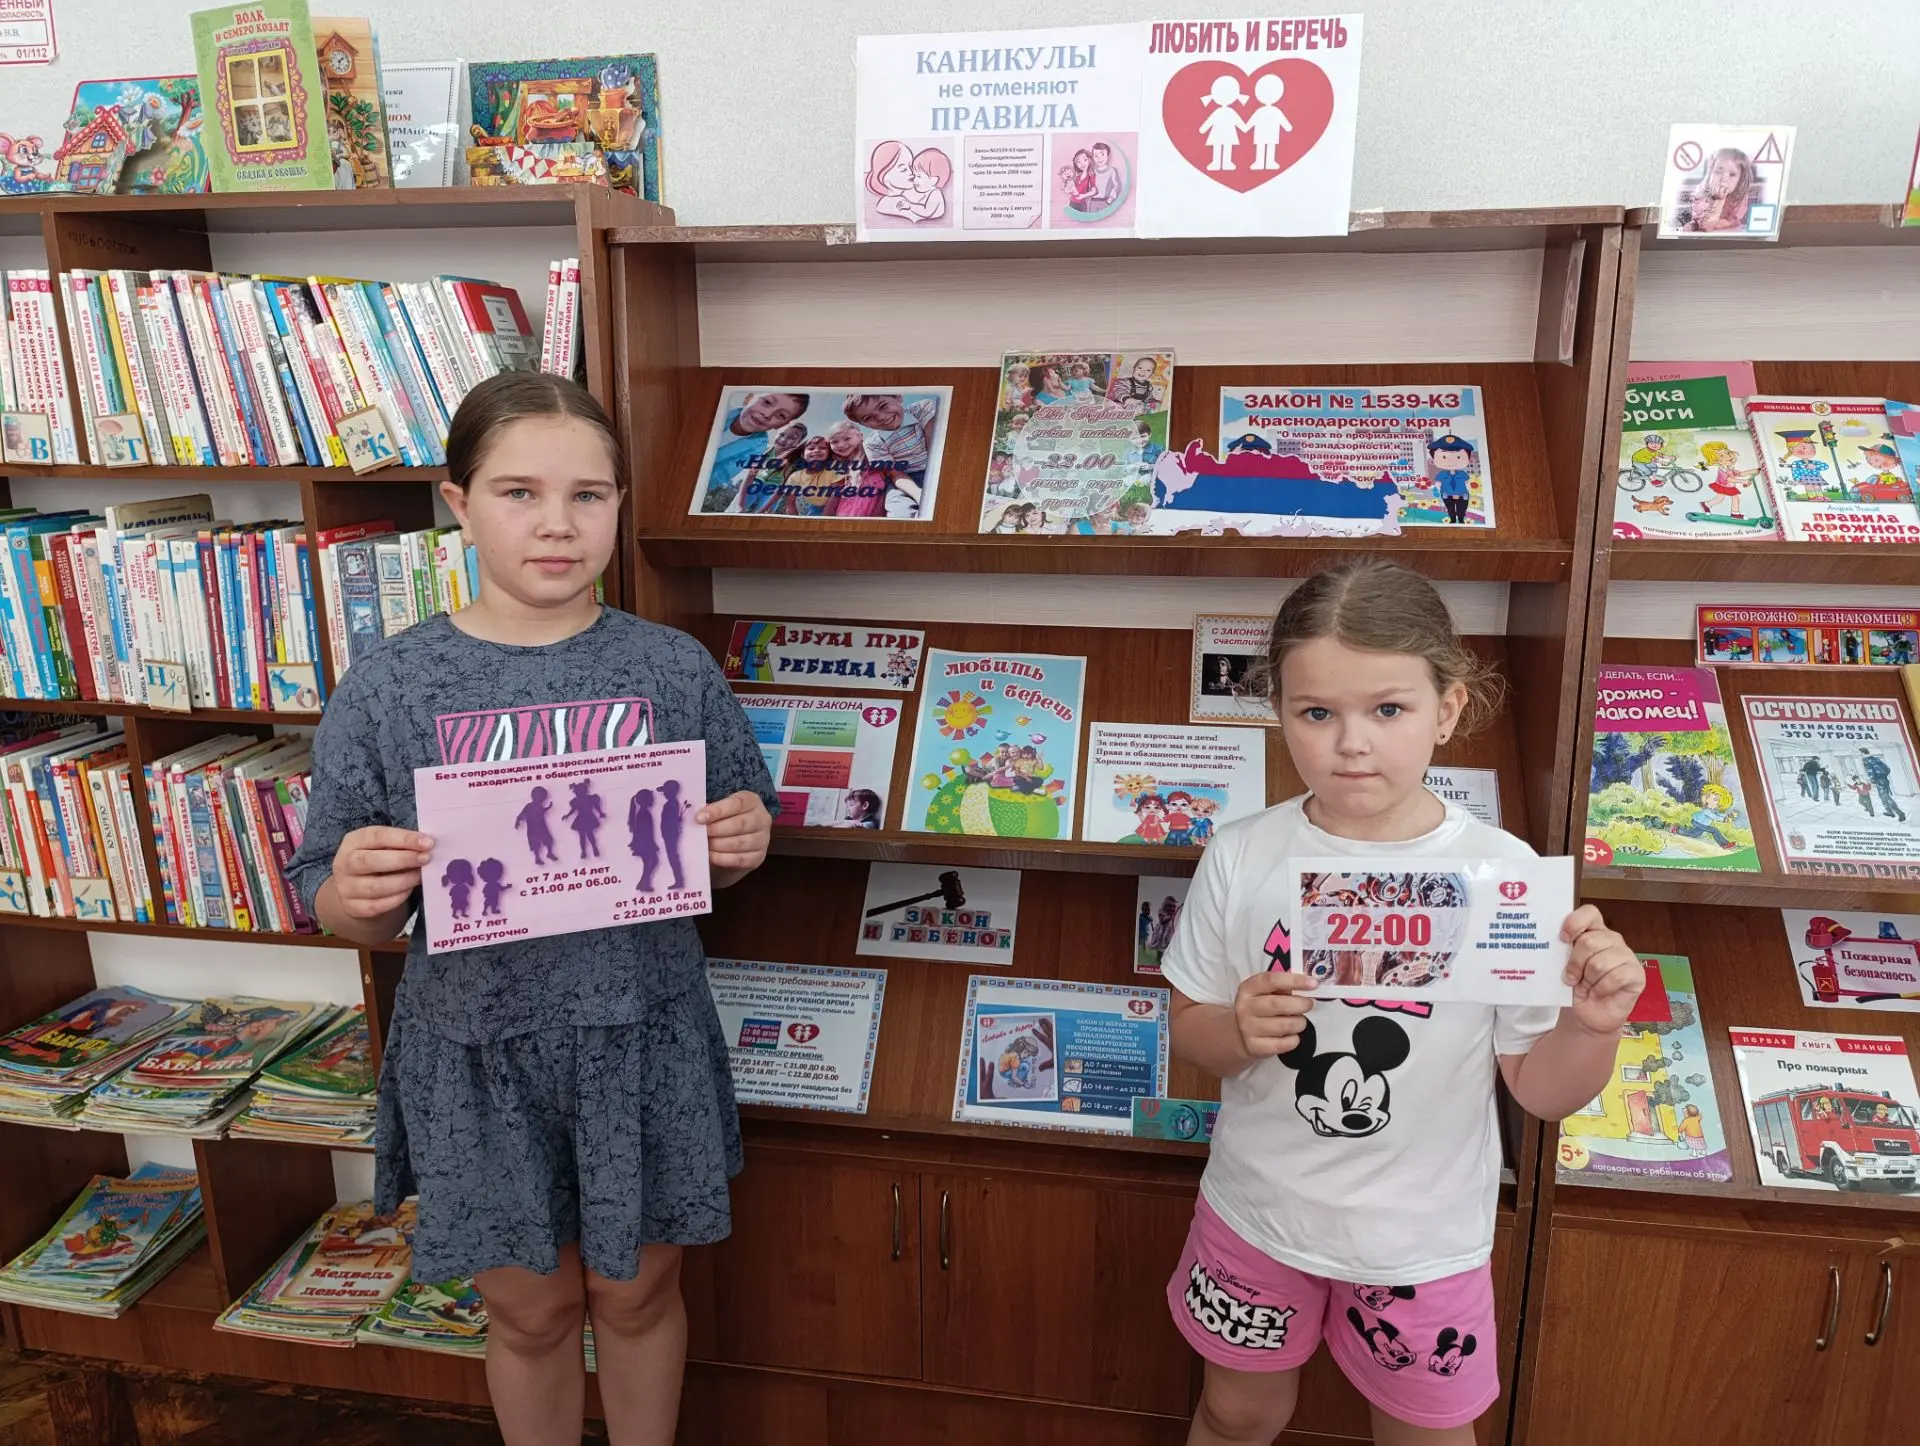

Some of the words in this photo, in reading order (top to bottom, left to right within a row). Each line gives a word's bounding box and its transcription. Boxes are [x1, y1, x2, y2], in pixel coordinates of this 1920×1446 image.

[235, 10, 264, 25] ВОЛК
[215, 34, 221, 42] И
[224, 27, 253, 39] СЕМЕРО
[256, 22, 289, 32] КОЗЛЯТ
[1150, 21, 1239, 54] ЛЮБИТЬ
[1245, 21, 1259, 51] И
[1267, 17, 1348, 52] БЕРЕЧЬ
[17, 48, 47, 58] 01/112
[916, 44, 1096, 75] КАНИКУЛЫ
[938, 80, 963, 98] не
[969, 77, 1078, 98] отменяют
[931, 104, 1078, 131] ПРАВИЛА
[237, 169, 266, 181] СКАЗКА
[275, 167, 307, 177] ОКОШКЕ
[1244, 394, 1322, 409] ЗАКОН
[1329, 395, 1354, 409] №
[1362, 393, 1461, 408] 1539-КЗ
[1764, 404, 1806, 412] ШКОЛЬНАЯ
[1248, 415, 1400, 428] Краснодарского
[1405, 417, 1450, 428] края
[1293, 432, 1327, 440] мерах
[1346, 432, 1425, 441] профилактике
[368, 433, 392, 460] К
[1301, 441, 1389, 450] безнадзорности
[1303, 452, 1400, 461] правонарушений
[794, 459, 909, 475] защите
[1814, 512, 1899, 523] ПРАВИЛА
[1801, 523, 1920, 536] ДОРОЖНОГО
[1713, 611, 1798, 623] ОСТОРОЖНО
[770, 626, 852, 647] АЗБУКА
[945, 660, 1044, 682] любить
[1605, 671, 1644, 681] ДЕЛАТЬ,
[1647, 672, 1684, 682] ЕСЛИ...
[816, 700, 862, 711] ЗАКОНА
[980, 680, 994, 690] и
[1005, 685, 1073, 722] беречь
[1750, 701, 1897, 720] ОСТОРОЖНО
[1097, 730, 1142, 739] Товарищи
[1780, 722, 1875, 732] НЕЗНАКОМЕЦ
[1816, 731, 1879, 740] УГРОЗА!
[1095, 758, 1141, 766] Хорошими
[1133, 751, 1187, 759] обязанности
[435, 772, 457, 780] Без
[460, 763, 548, 779] сопровождения
[552, 757, 605, 769] взрослых
[607, 754, 630, 763] дети
[650, 747, 691, 758] должны
[468, 776, 533, 788] находиться
[545, 765, 624, 780] общественных
[627, 760, 662, 769] местах
[1444, 791, 1469, 800] НЕТ
[1584, 845, 1607, 861] 5+
[526, 876, 539, 884] от
[543, 873, 549, 881] 7
[554, 872, 569, 882] до
[572, 868, 586, 877] 14
[589, 866, 610, 876] лет
[531, 883, 564, 896] 21.00
[568, 882, 582, 892] до
[586, 875, 621, 888] 06.00.
[615, 900, 629, 908] от
[633, 896, 646, 906] 14
[649, 894, 663, 905] до
[666, 891, 680, 901] 18
[683, 890, 702, 899] лет
[624, 907, 655, 920] 22.00
[658, 906, 672, 916] до
[676, 900, 706, 912] 06.00
[1496, 912, 1529, 920] Следит
[453, 922, 470, 933] До
[474, 920, 482, 929] 7
[486, 917, 507, 928] лет
[906, 910, 989, 928] ЗАКОН
[434, 926, 528, 948] круглосуточно
[1327, 913, 1431, 947] 22:00
[1501, 941, 1549, 949] часовщик!
[1841, 950, 1912, 965] Пожарная
[710, 972, 740, 981] Каково
[742, 975, 776, 983] главное
[778, 978, 828, 988] требование
[1844, 965, 1916, 983] безопасность
[1742, 1035, 1787, 1046] ПЕРВАЯ
[1801, 1041, 1832, 1050] КНИГА
[1847, 1043, 1892, 1053] ЗНАНИЙ
[1777, 1060, 1802, 1072] Про
[1805, 1063, 1868, 1076] пожарных
[1560, 1144, 1583, 1162] 5+
[1592, 1163, 1640, 1175] поговорите
[1643, 1166, 1648, 1174] с
[1693, 1170, 1704, 1179] об
[311, 1267, 395, 1282] Медведь
[1216, 1260, 1261, 1299] Disney
[299, 1285, 381, 1298] девочка
[341, 1279, 355, 1288] и
[1188, 1259, 1297, 1328] MICKEY
[1185, 1287, 1287, 1349] MOUSE
